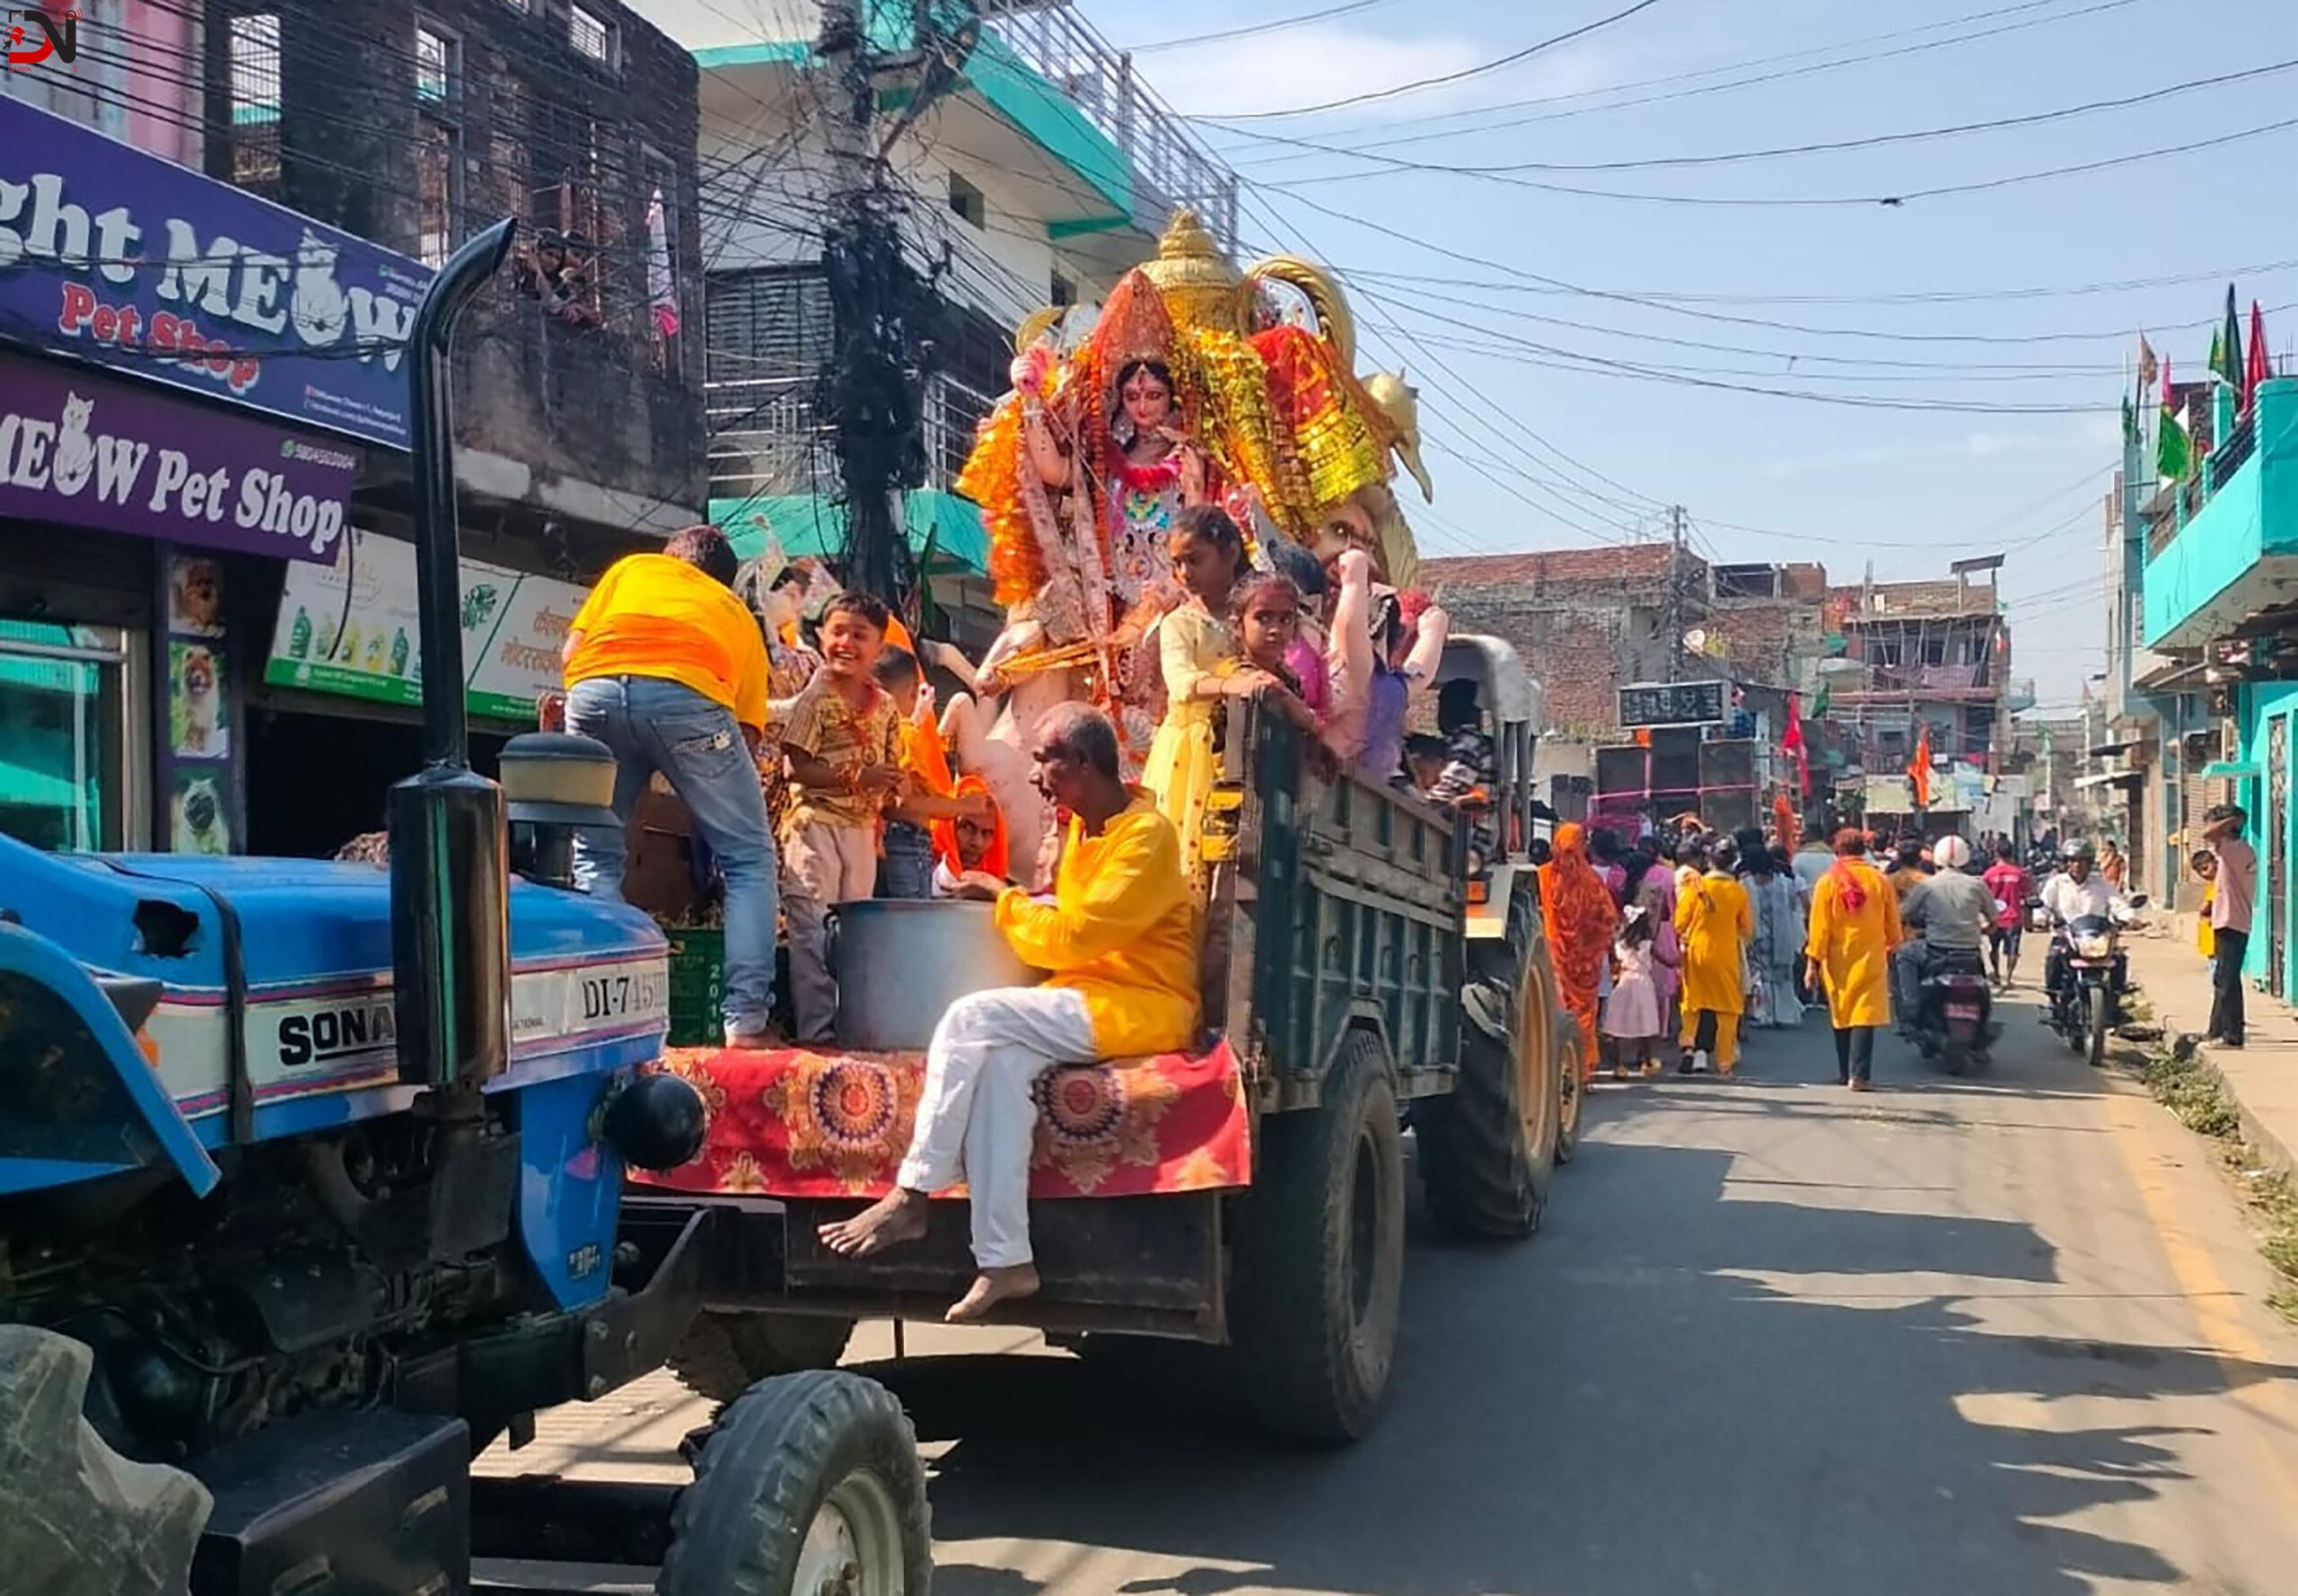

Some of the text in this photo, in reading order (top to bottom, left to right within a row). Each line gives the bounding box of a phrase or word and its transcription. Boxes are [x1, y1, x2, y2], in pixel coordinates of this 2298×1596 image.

[58, 281, 261, 396] Pet Shop
[149, 449, 230, 522] Pet
[235, 468, 343, 554] Shop
